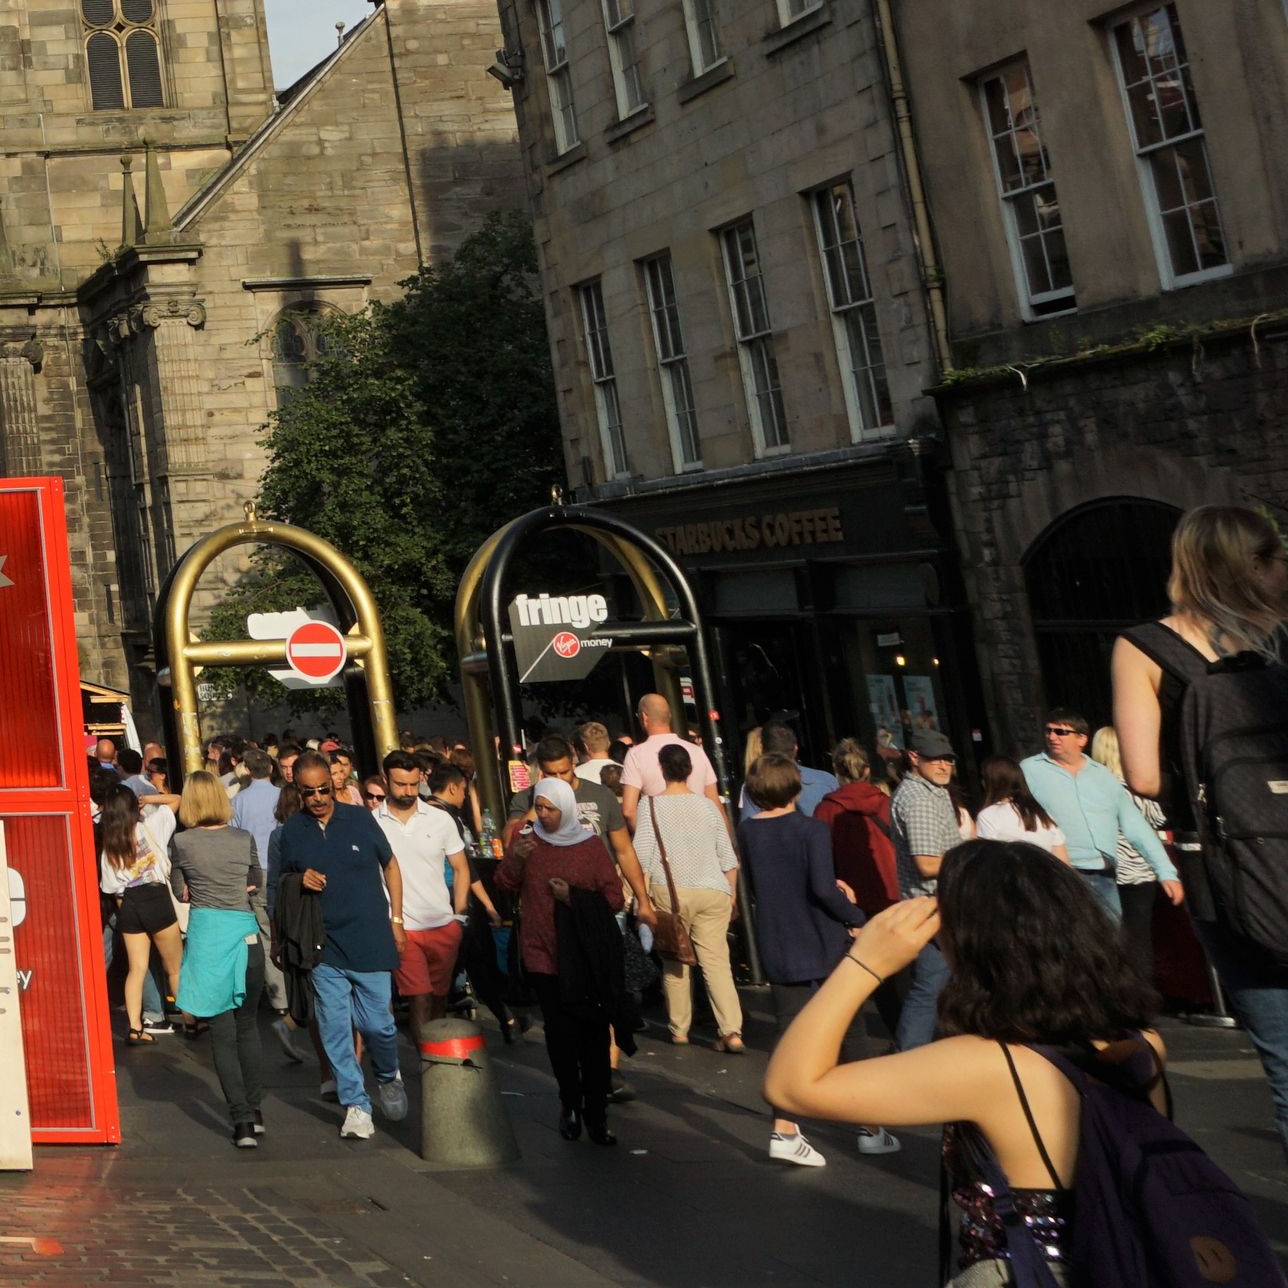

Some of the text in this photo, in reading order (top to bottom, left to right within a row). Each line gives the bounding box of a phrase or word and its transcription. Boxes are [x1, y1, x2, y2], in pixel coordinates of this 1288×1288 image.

[656, 507, 845, 555] STARBUCKS COFFEE
[515, 593, 608, 629] fringe
[556, 635, 613, 655] Virgin money
